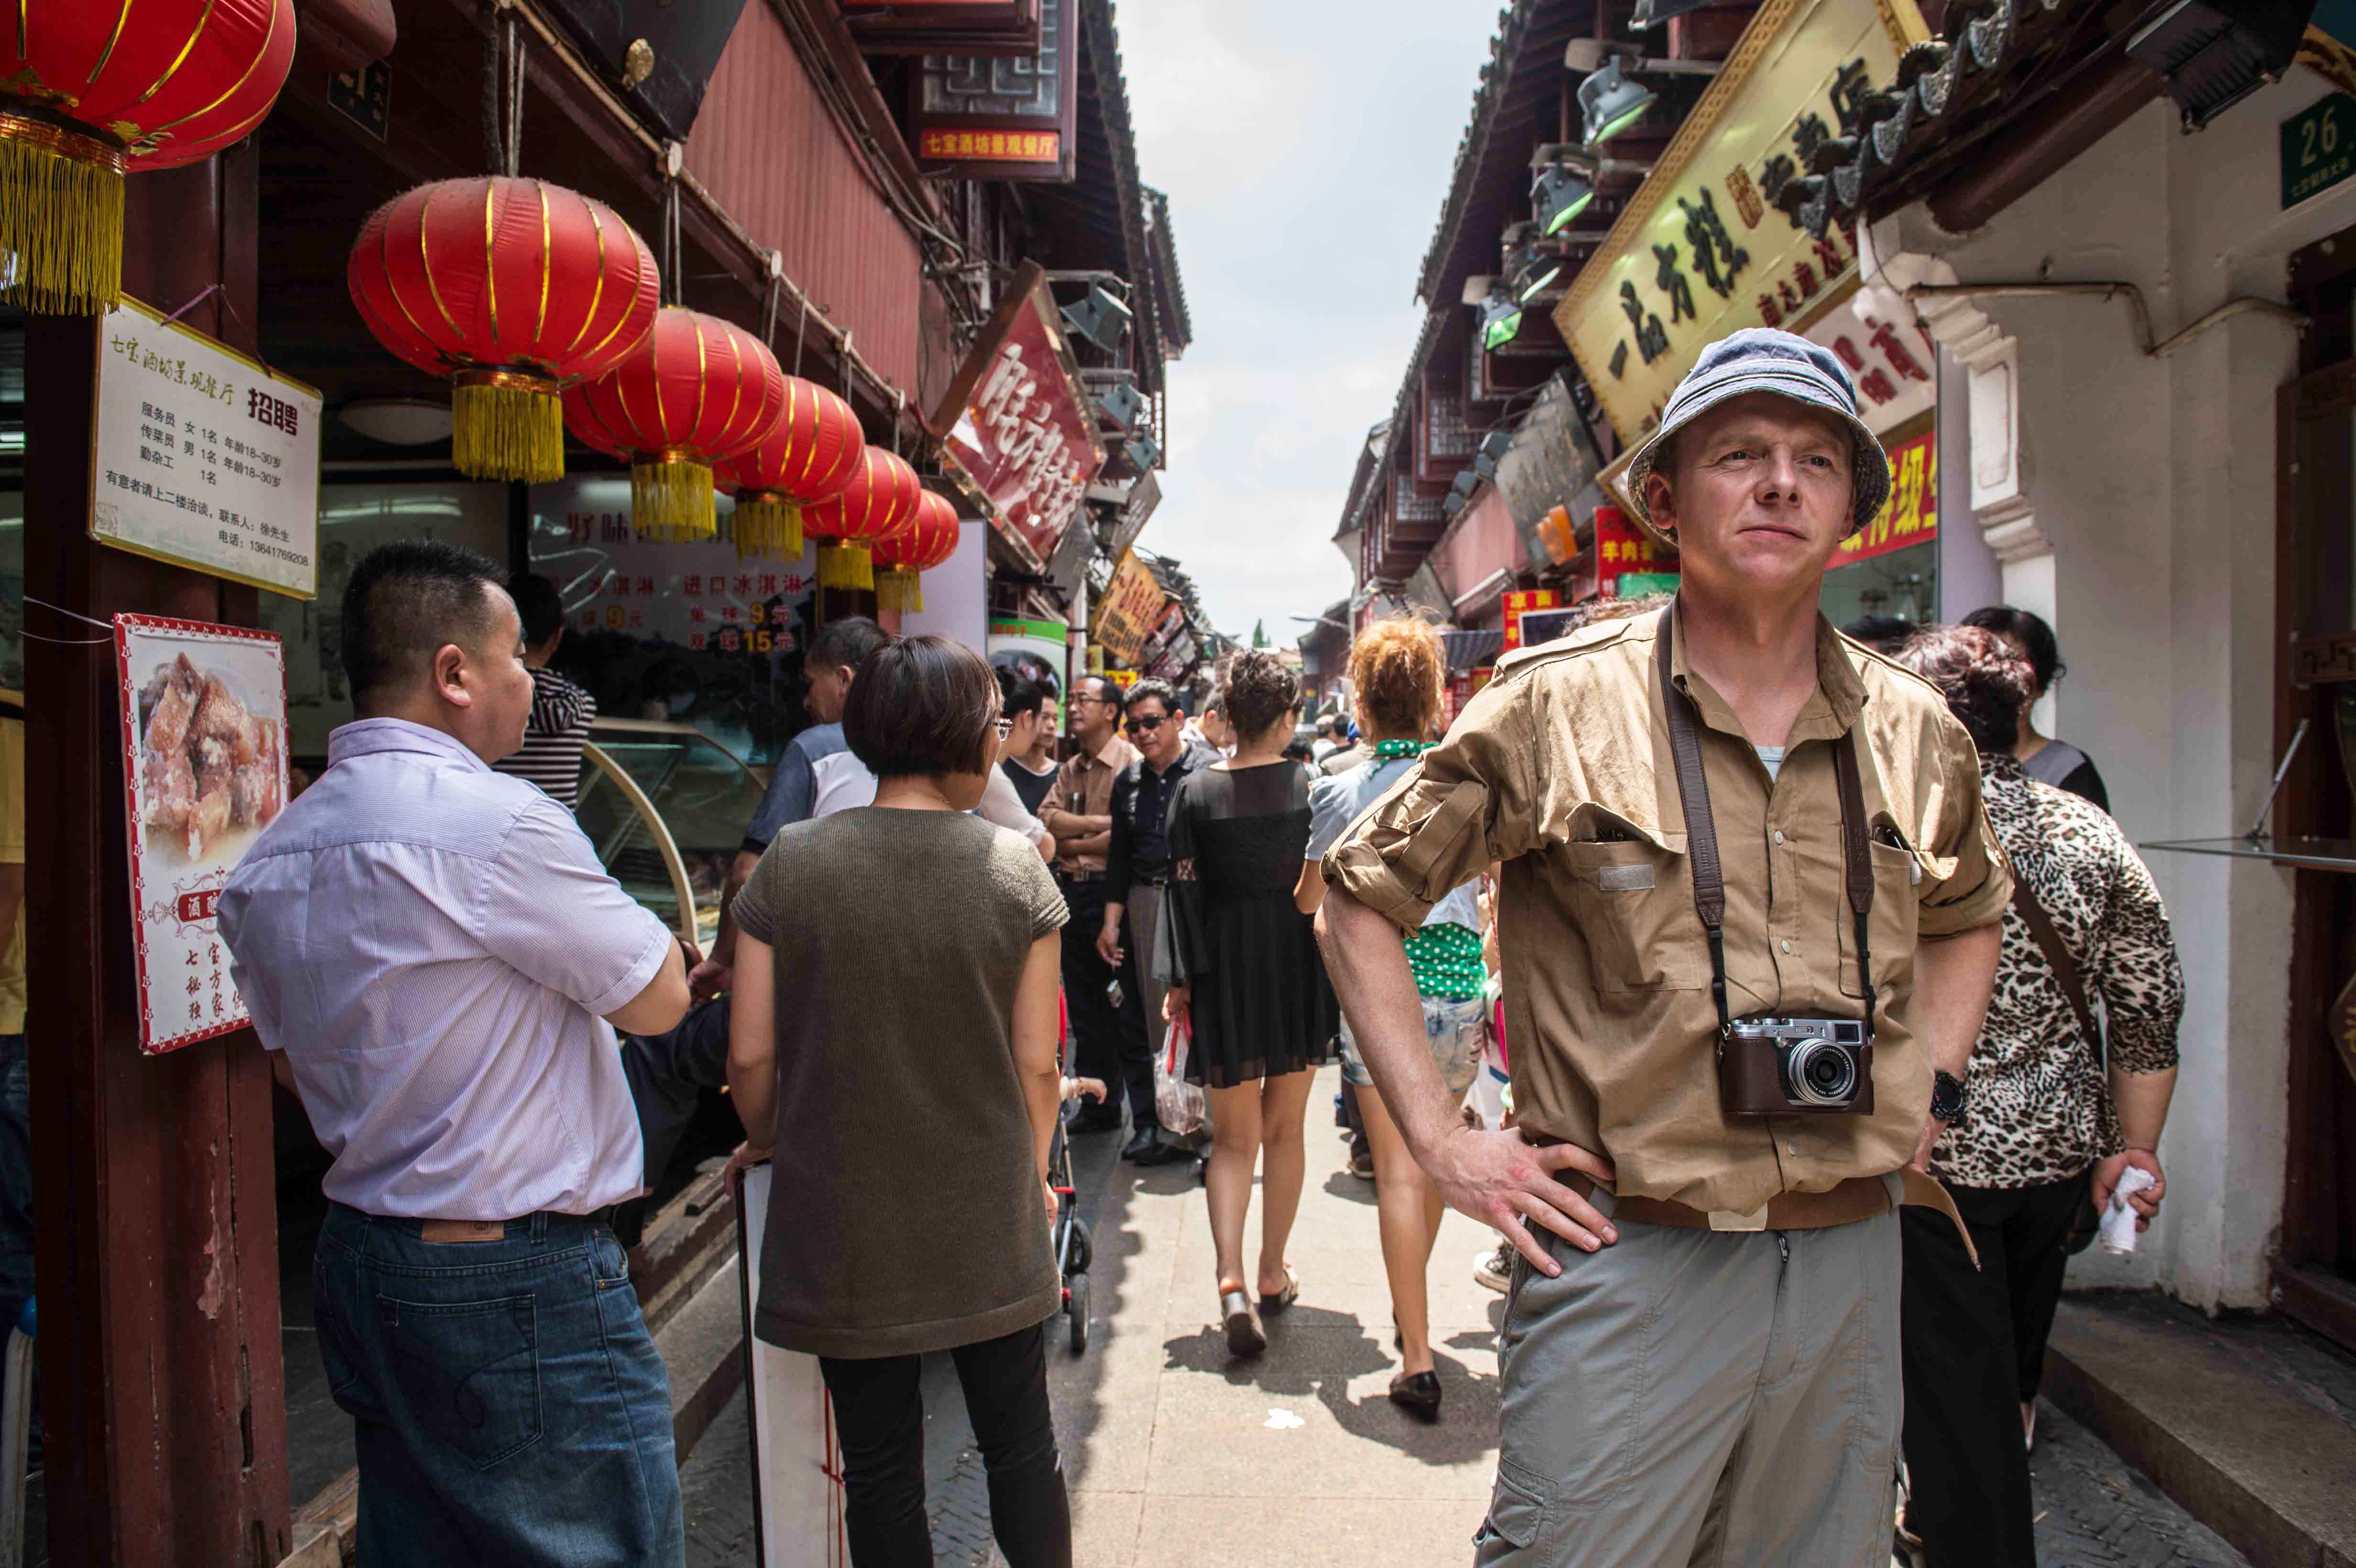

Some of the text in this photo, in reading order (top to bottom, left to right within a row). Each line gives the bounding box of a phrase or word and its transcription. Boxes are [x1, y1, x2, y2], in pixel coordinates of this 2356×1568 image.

[2301, 104, 2338, 168] 26
[142, 401, 282, 470] 服务员 女 1名 年龄18-30岁
[247, 386, 298, 437] 招聘
[140, 445, 217, 486] 勤杂工 1名
[141, 423, 282, 489] 传菜员 男 1名 年龄18-30岁
[682, 573, 804, 596] 进口冰淇淋
